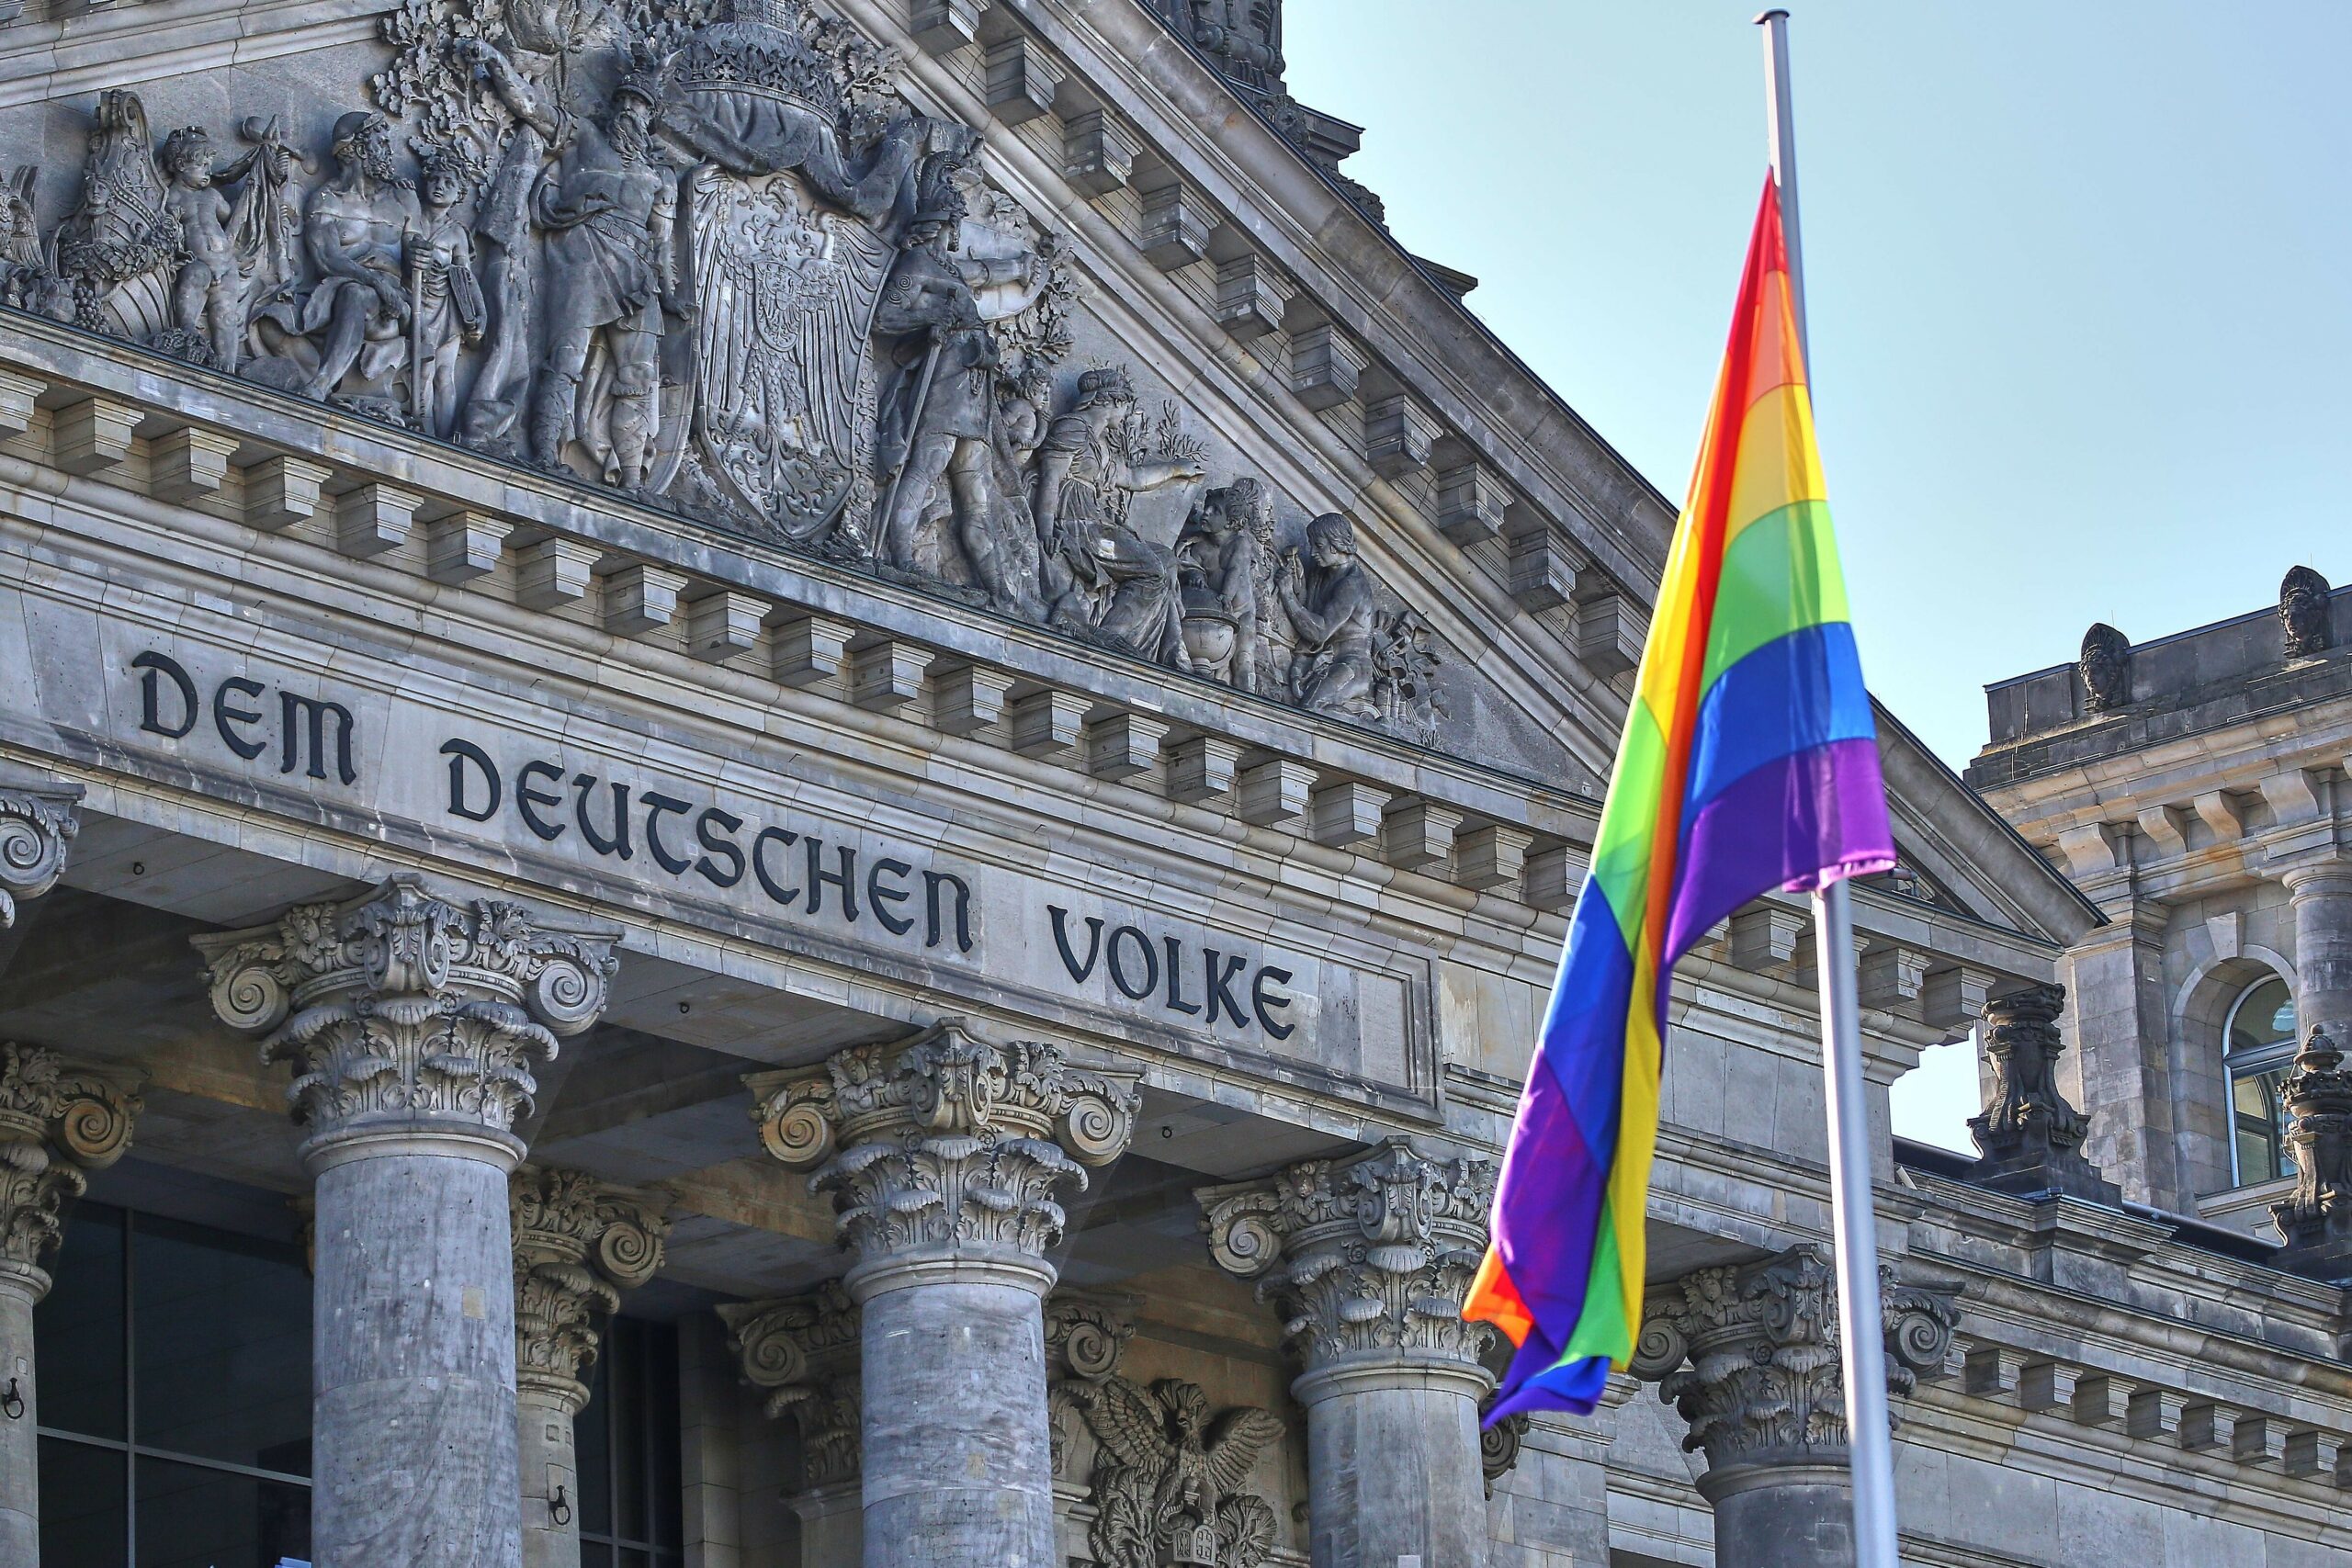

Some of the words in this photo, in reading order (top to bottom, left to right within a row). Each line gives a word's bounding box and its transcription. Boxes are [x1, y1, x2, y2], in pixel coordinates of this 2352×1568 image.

[132, 650, 356, 785] DEM
[440, 738, 973, 953] DEUTSCHEN
[1047, 905, 1295, 1041] VOLKE
